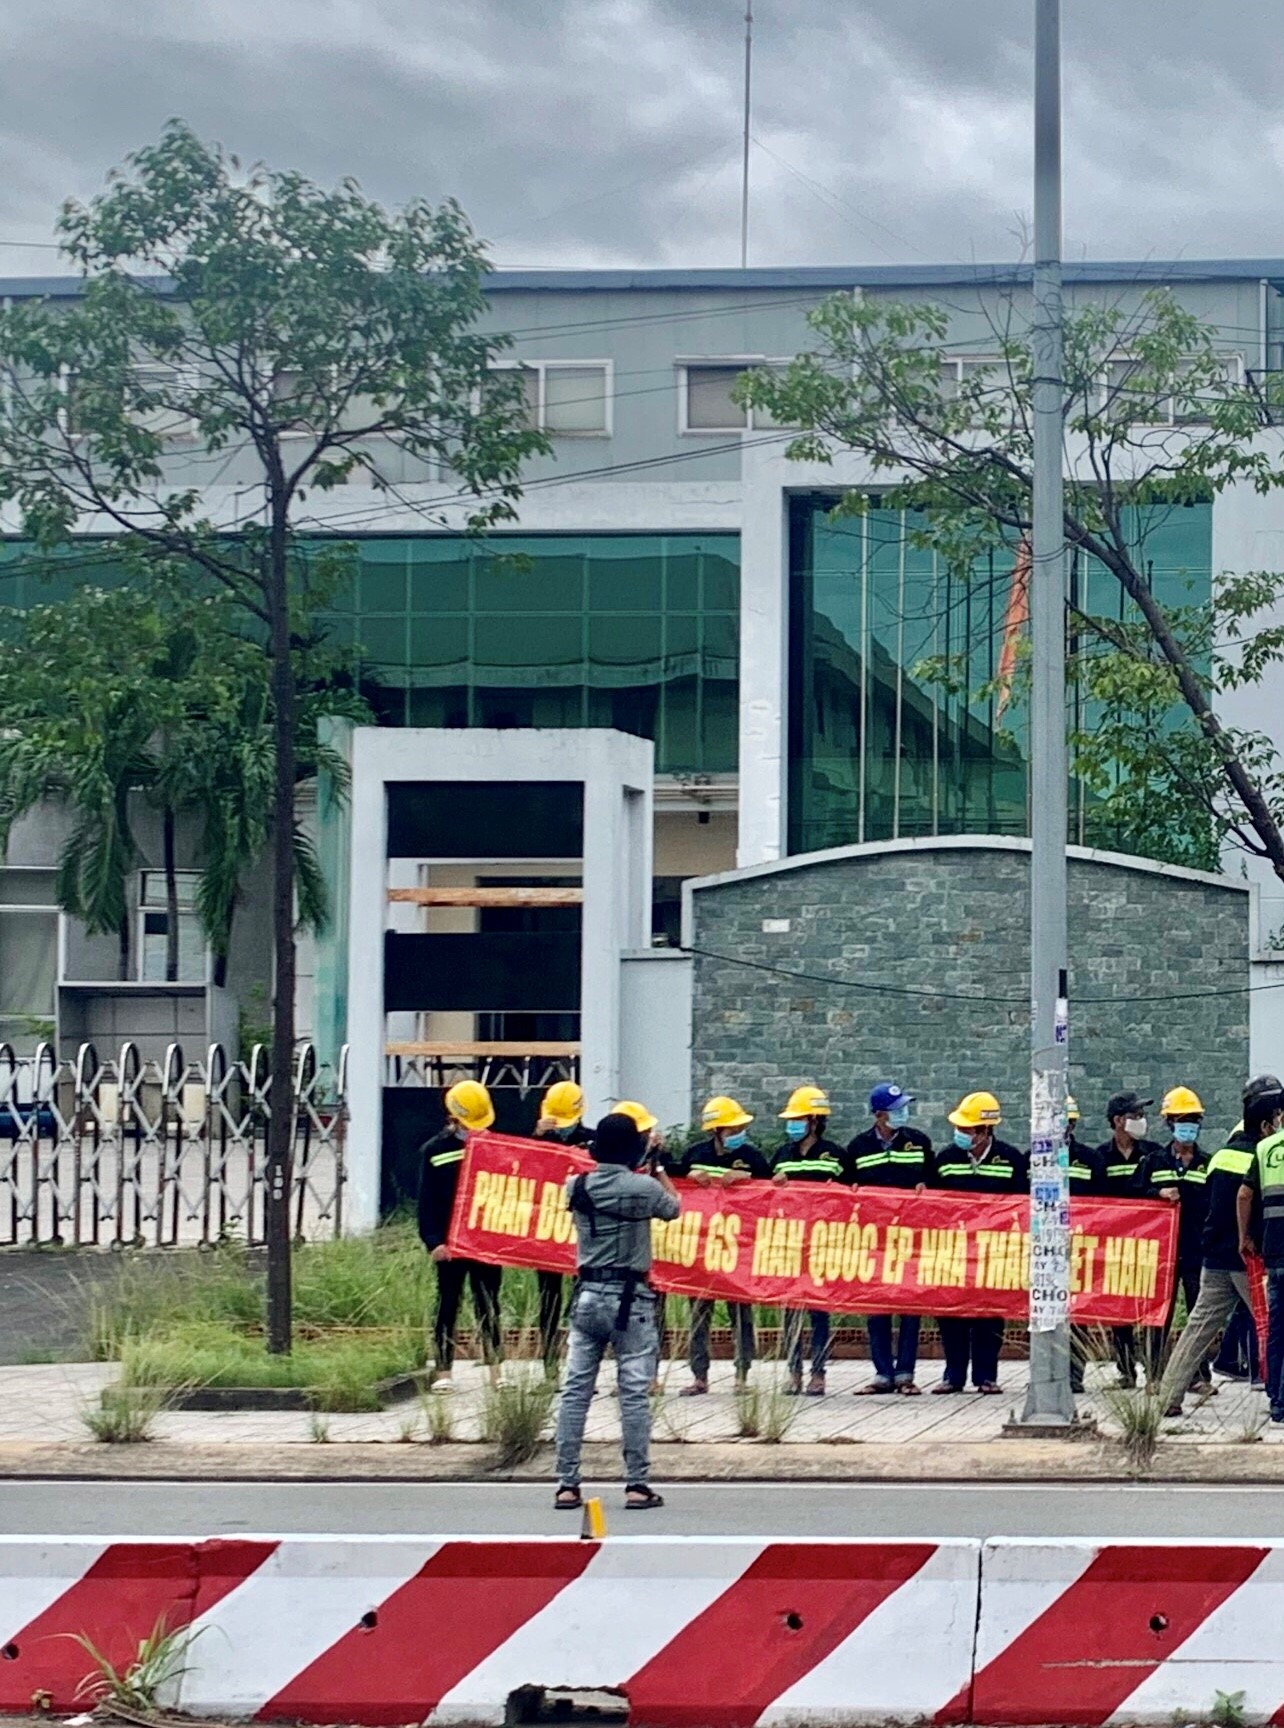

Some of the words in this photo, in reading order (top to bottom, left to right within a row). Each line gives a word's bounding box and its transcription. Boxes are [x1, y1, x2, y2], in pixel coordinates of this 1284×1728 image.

[467, 1160, 536, 1237] PHẢN
[535, 1166, 578, 1245] ĐỐ
[705, 1212, 741, 1273] GS
[752, 1208, 805, 1278] HÀN
[808, 1203, 878, 1287] QUỐC
[881, 1216, 914, 1285] ÉP
[916, 1220, 967, 1288] NHÀ
[1102, 1236, 1159, 1299] NAM
